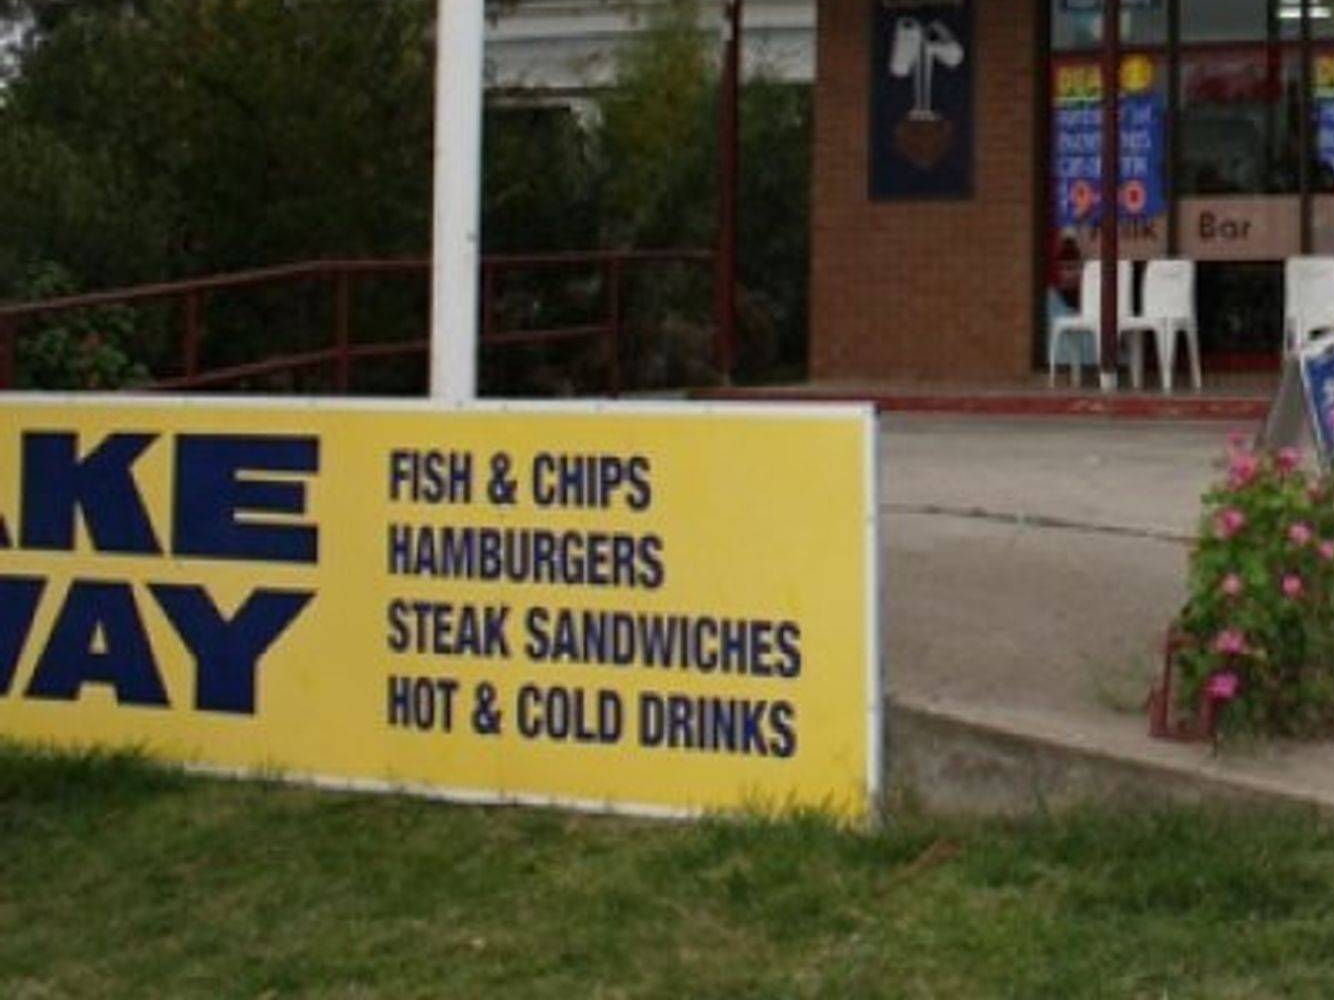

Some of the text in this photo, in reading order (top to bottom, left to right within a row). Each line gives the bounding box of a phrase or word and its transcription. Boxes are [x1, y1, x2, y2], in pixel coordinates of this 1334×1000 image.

[1199, 210, 1252, 242] Bar
[0, 432, 320, 565] KE
[387, 448, 653, 512] FISH & CHIPS
[387, 523, 666, 590] HAMBURGERS
[387, 597, 803, 679] STEAK SANDWICHES
[386, 675, 798, 759] HOT & COLD DRINKS
